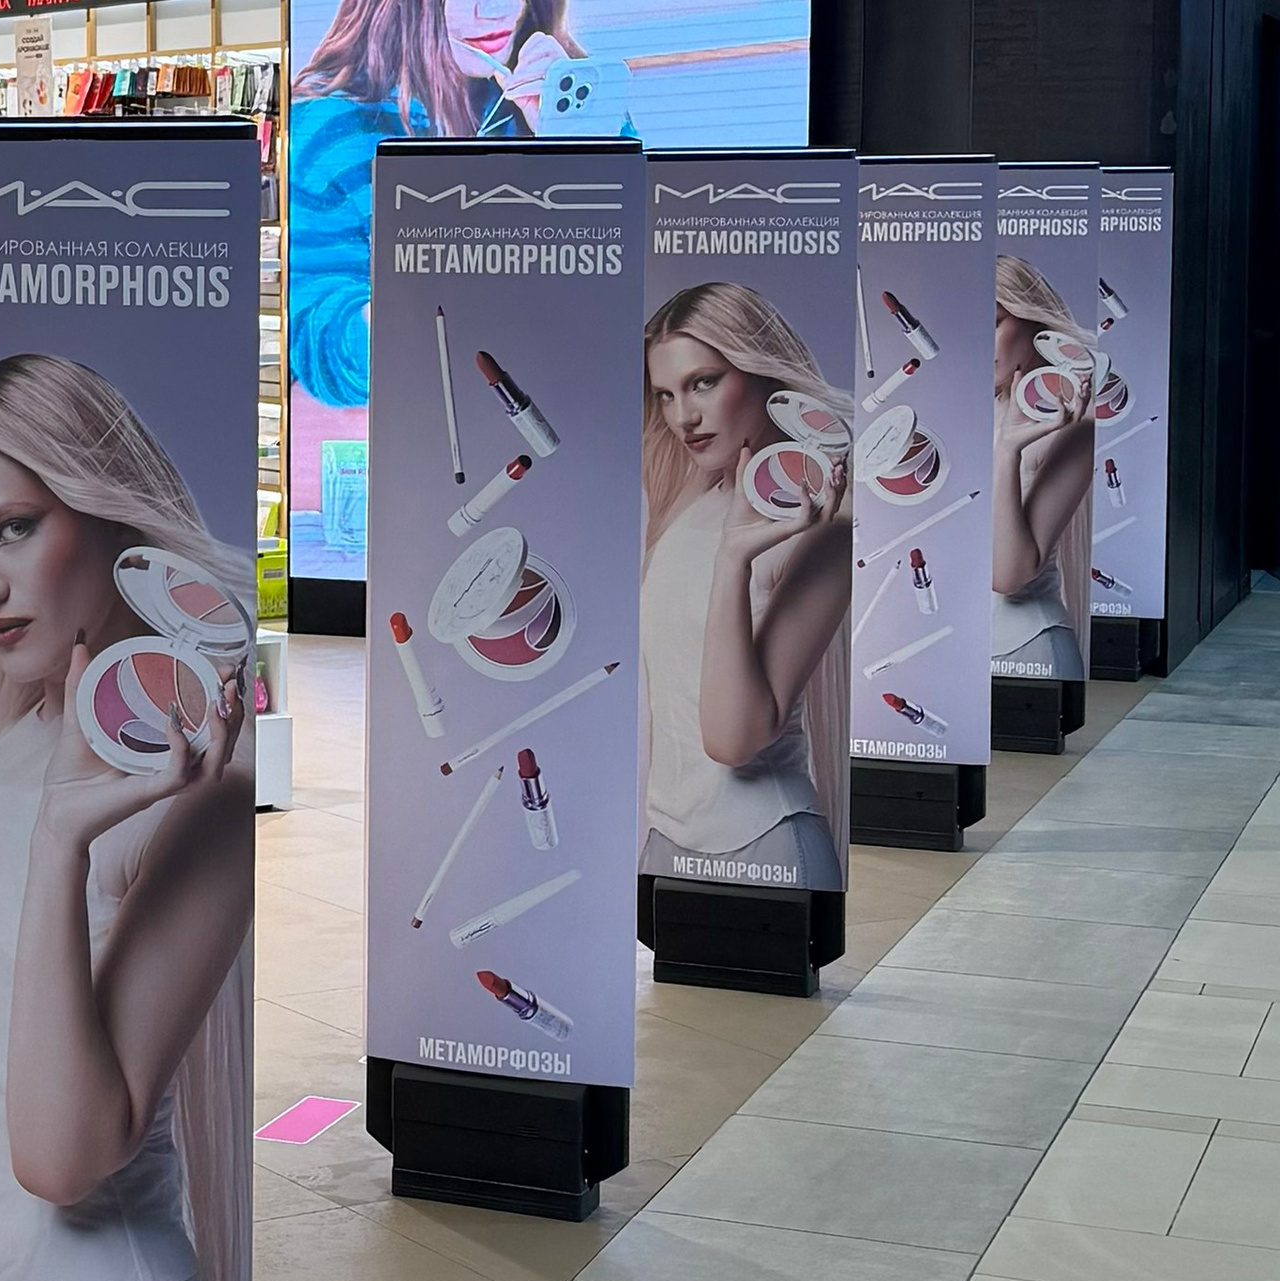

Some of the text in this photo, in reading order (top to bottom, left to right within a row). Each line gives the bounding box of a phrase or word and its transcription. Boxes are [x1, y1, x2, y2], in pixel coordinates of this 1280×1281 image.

[397, 226, 621, 240] ЛИМИТИРОВАННАЯ КОЛЛЕКЦИЯ
[656, 217, 840, 228] ЛИМИТИРОВАННАЯ КОЛЛЕКЦИЯ
[858, 221, 983, 242] AMORPHOSIS
[114, 241, 229, 260] КОЛЛЕКЦИЯ
[654, 230, 841, 255] METAMORPHOSIS
[394, 243, 623, 275] METAMORPHOSIS
[673, 856, 797, 884] МЕТАМОРФОЗЫ
[419, 1037, 571, 1075] МЕТАМОРФОЗЫ
